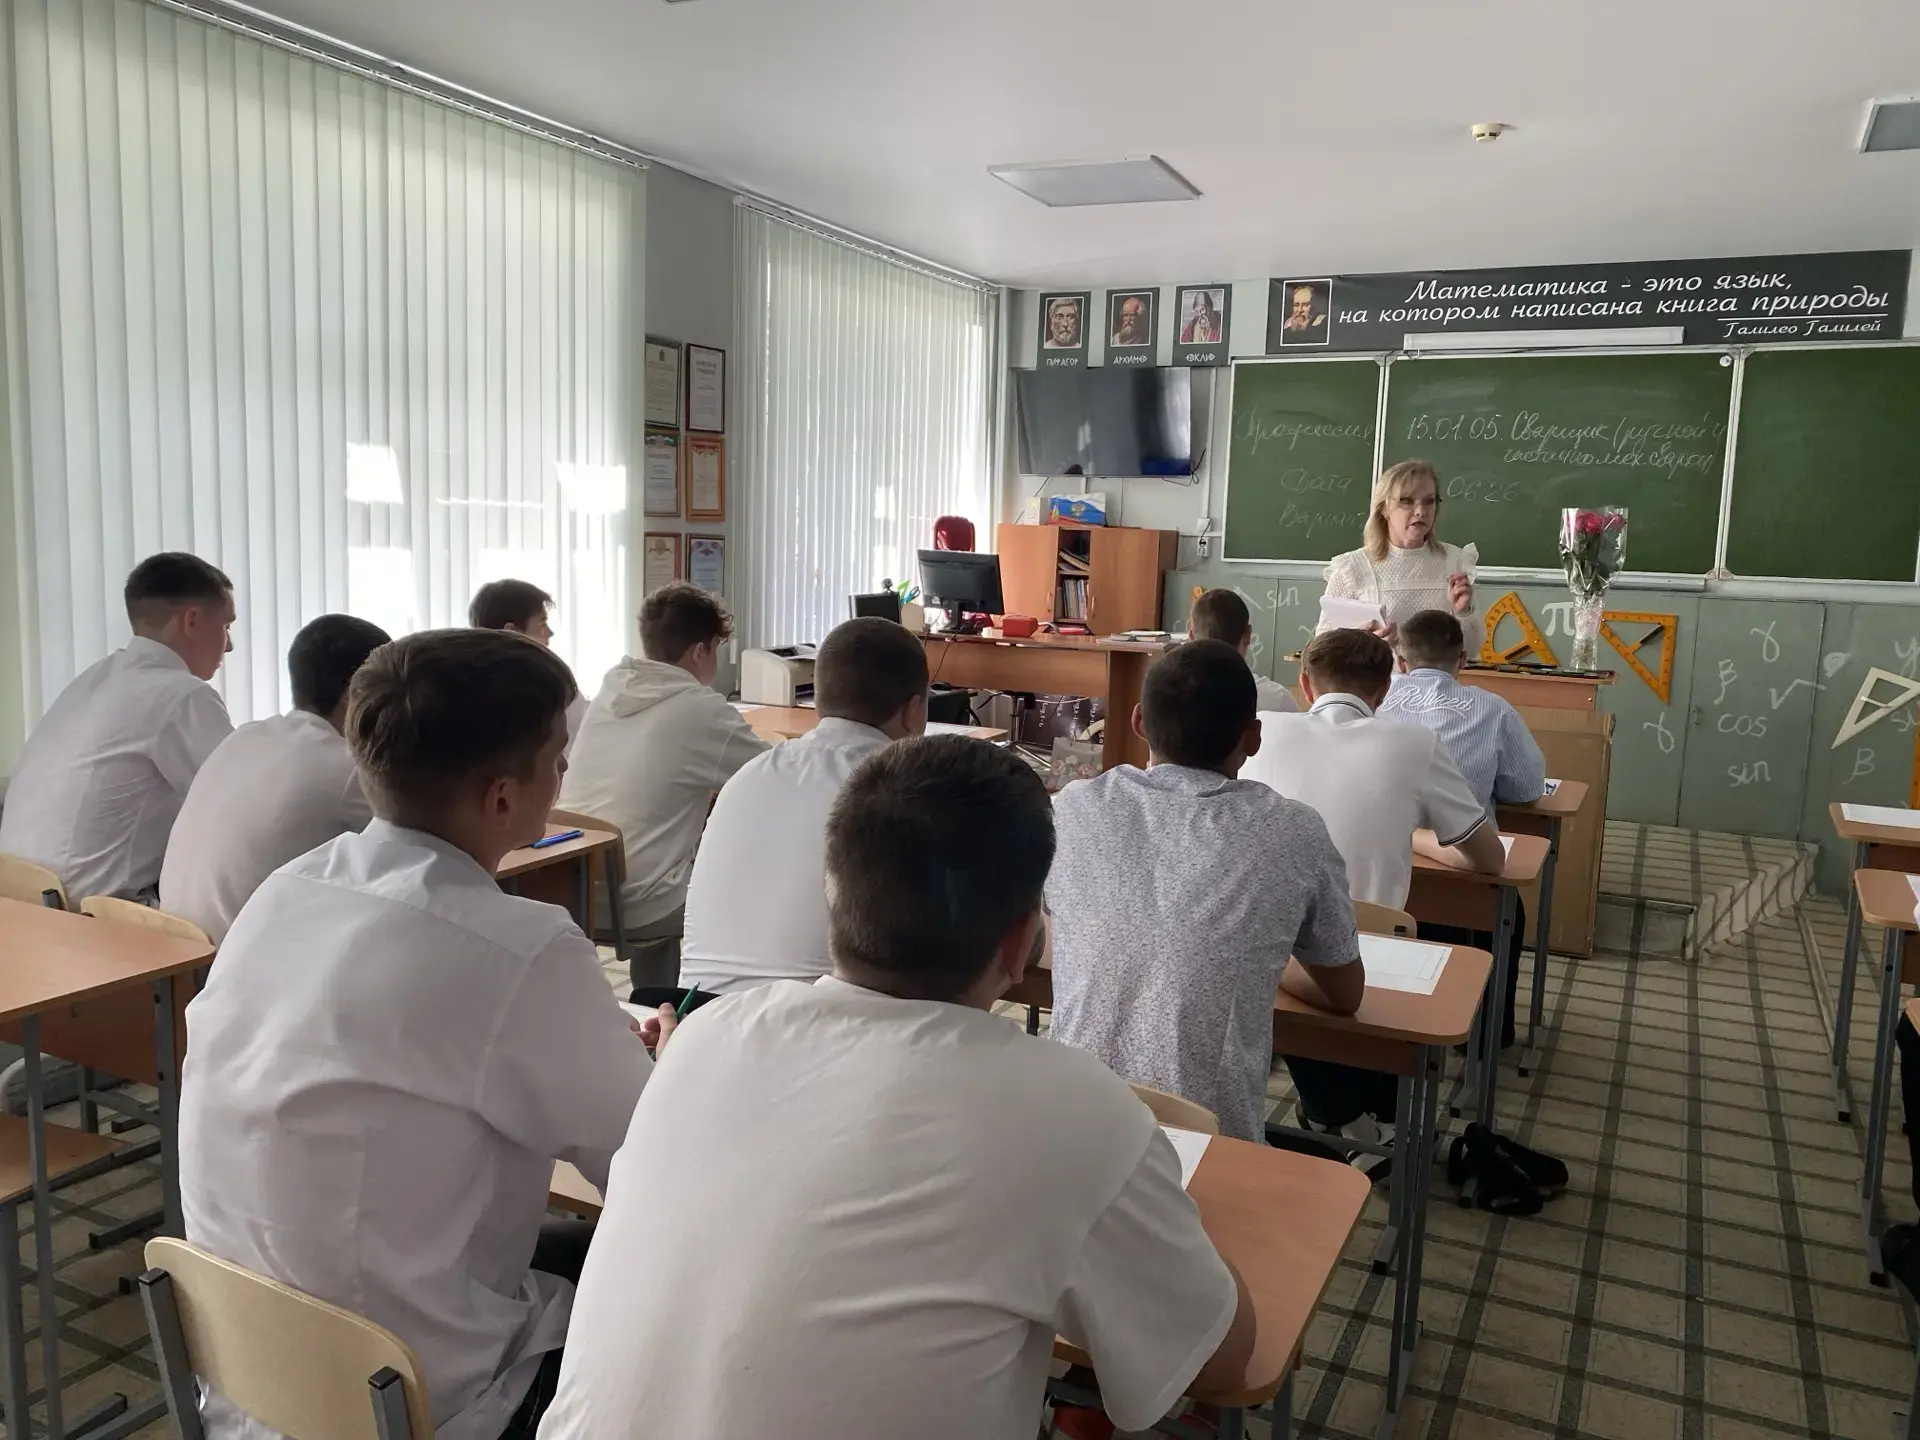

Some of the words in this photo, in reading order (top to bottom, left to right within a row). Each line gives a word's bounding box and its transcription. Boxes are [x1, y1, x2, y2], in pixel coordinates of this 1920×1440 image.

[1404, 279, 1608, 303] Математика
[1642, 275, 1702, 293] это
[1712, 272, 1793, 291] язык,
[1338, 308, 1368, 324] на
[1378, 303, 1501, 326] котором
[1510, 299, 1643, 319] написана
[1655, 294, 1738, 314] книга
[1751, 284, 1889, 316] природы
[1722, 321, 1798, 338] Галилео
[1802, 319, 1882, 337] Галилей
[1046, 357, 1079, 367] ПИФАГОР
[1266, 586, 1300, 610] sin
[1717, 712, 1768, 738] cos
[1727, 760, 1772, 788] sin
